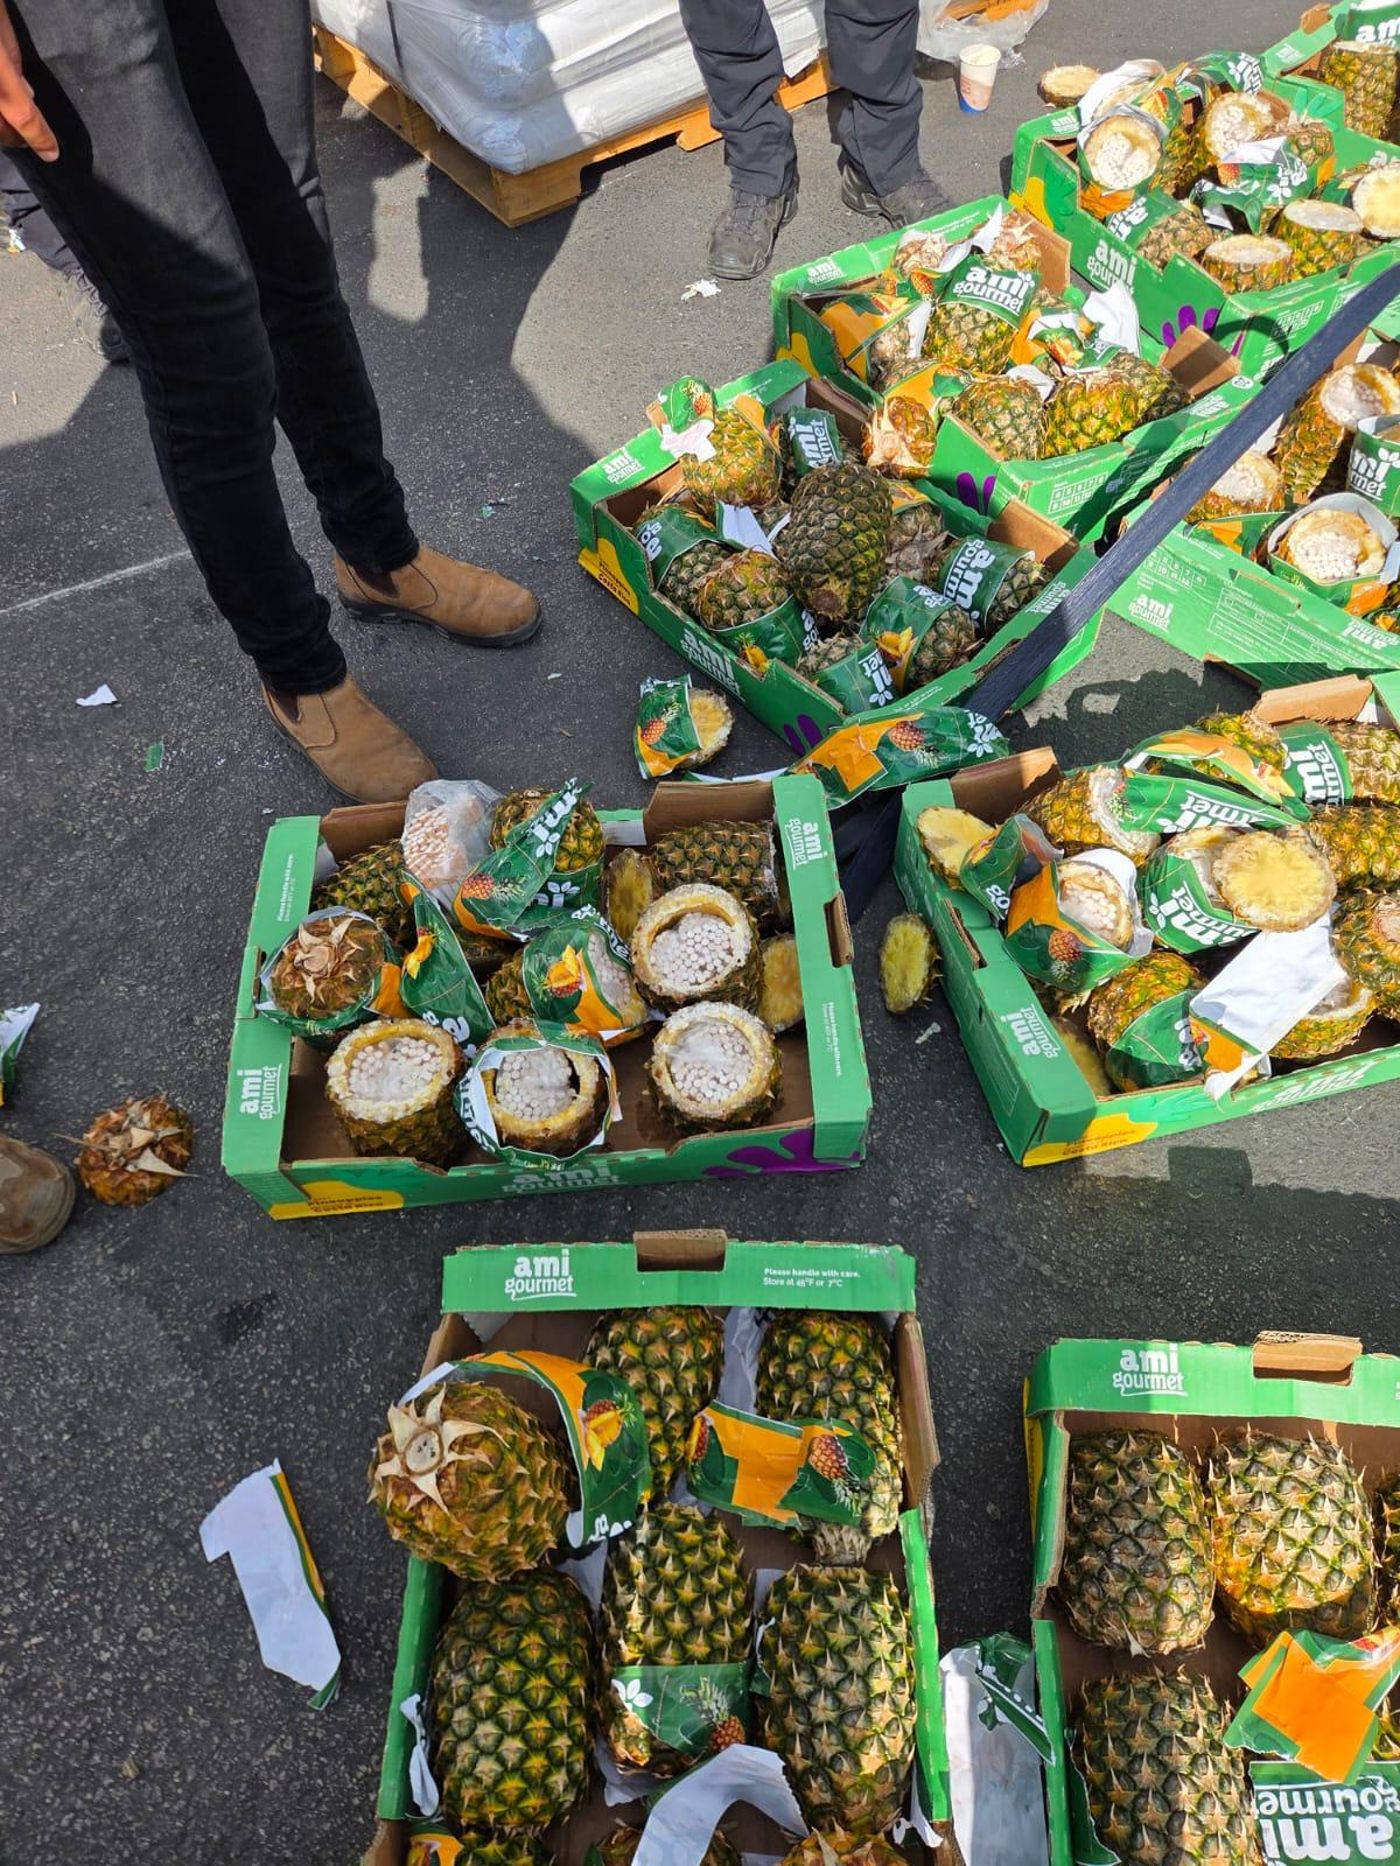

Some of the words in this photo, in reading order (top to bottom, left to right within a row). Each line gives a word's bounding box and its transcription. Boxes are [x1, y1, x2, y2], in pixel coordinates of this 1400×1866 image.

[1355, 16, 1400, 43] am
[807, 257, 836, 278] ami
[965, 265, 1030, 294] ami
[1094, 239, 1138, 286] ami
[602, 452, 634, 475] ami
[1350, 448, 1391, 483] mi
[944, 539, 984, 600] gourm
[956, 549, 997, 609] am
[1137, 593, 1174, 619] ami
[684, 628, 736, 687] ami
[788, 818, 809, 866] gourmet
[803, 821, 828, 860] ami
[1170, 886, 1258, 939] urmet
[1001, 1011, 1041, 1056] ami
[1021, 1006, 1060, 1059] gourmet
[237, 1069, 262, 1113] ami
[259, 1066, 279, 1119] gourmet
[513, 1159, 611, 1184] ami
[514, 1249, 569, 1277] ami
[764, 1267, 791, 1276] Please
[792, 1268, 820, 1277] handle
[821, 1269, 839, 1278] with
[840, 1270, 860, 1279] care.
[505, 1275, 574, 1297] gourmet
[763, 1277, 785, 1286] Store
[786, 1278, 795, 1286] at
[1119, 1343, 1178, 1374] ami
[1112, 1370, 1184, 1395] gourmet
[1259, 1813, 1394, 1861] ami
